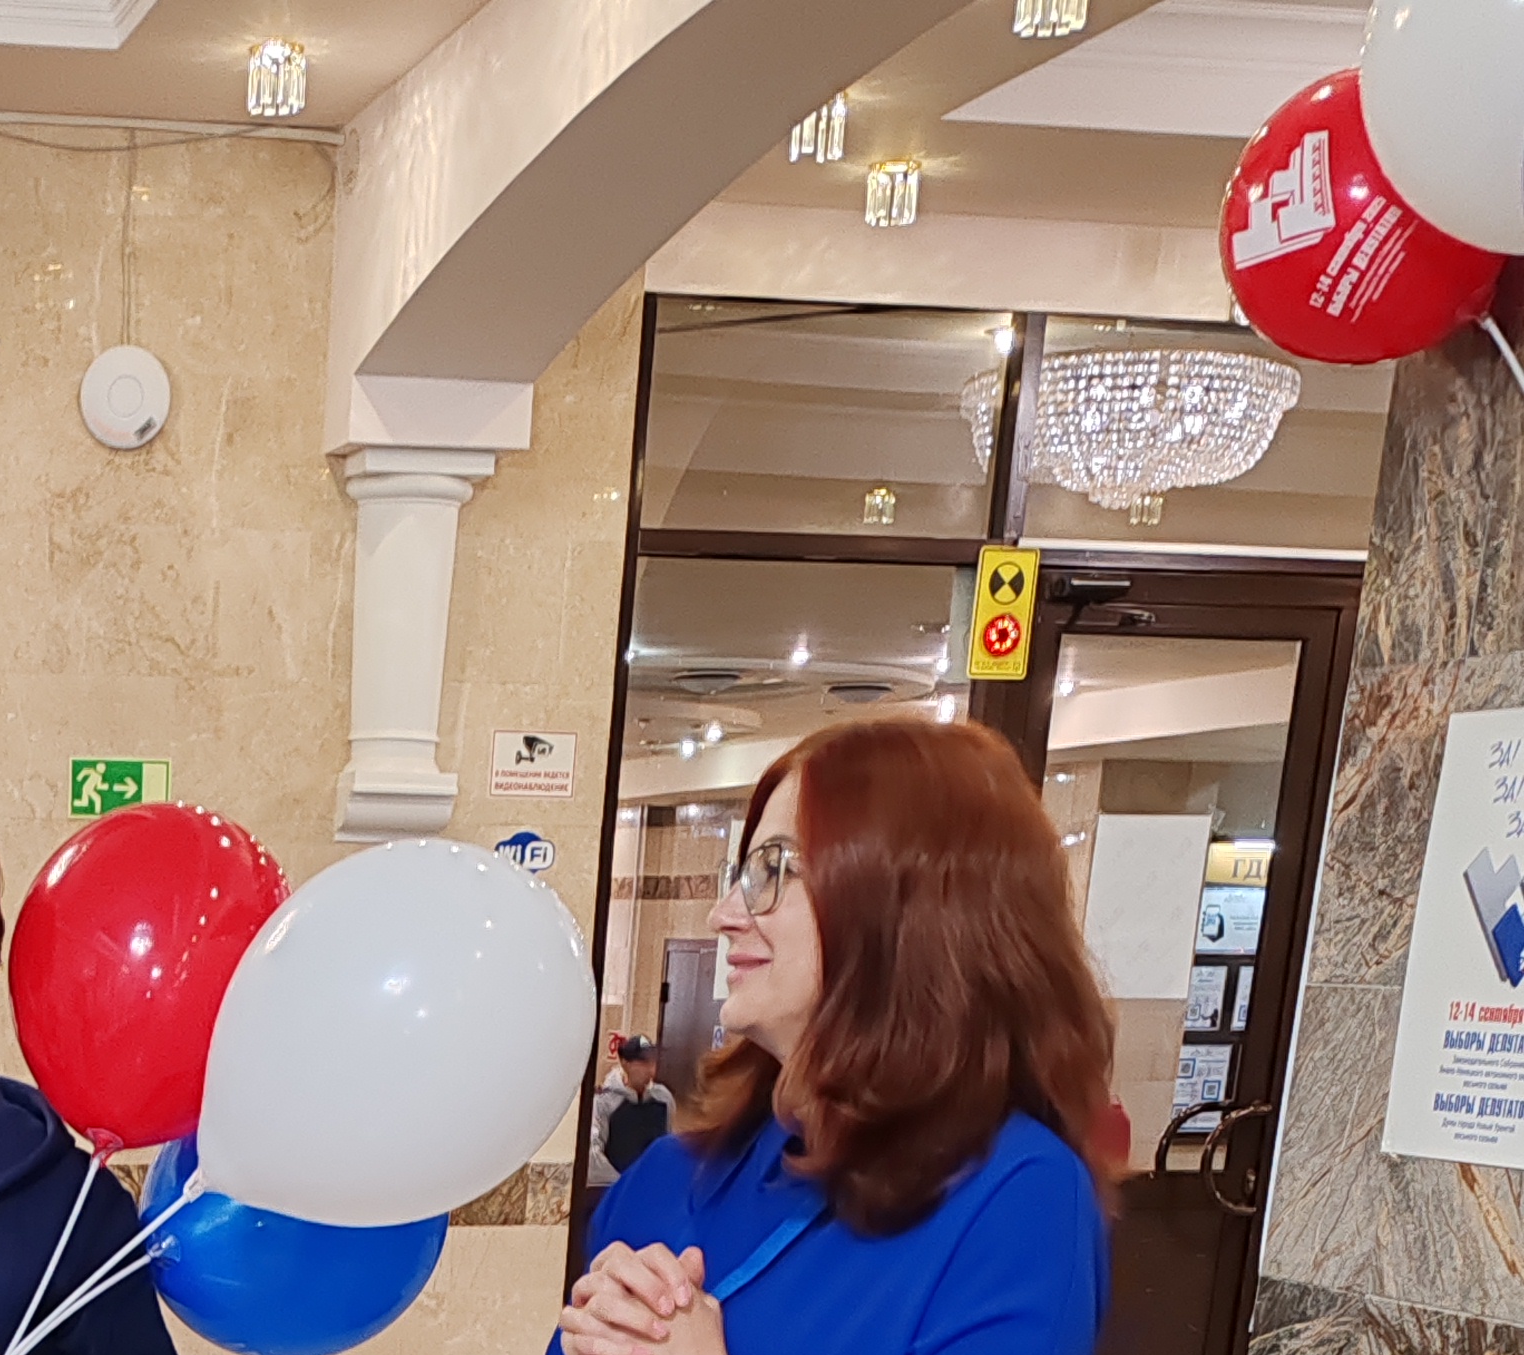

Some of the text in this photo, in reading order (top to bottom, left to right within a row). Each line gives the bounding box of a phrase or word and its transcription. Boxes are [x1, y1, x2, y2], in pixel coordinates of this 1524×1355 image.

[1449, 1000, 1476, 1021] 12-14
[1443, 1029, 1487, 1051] ВЫБОРЫ
[1433, 1092, 1476, 1114] ВЫБОРЫ
